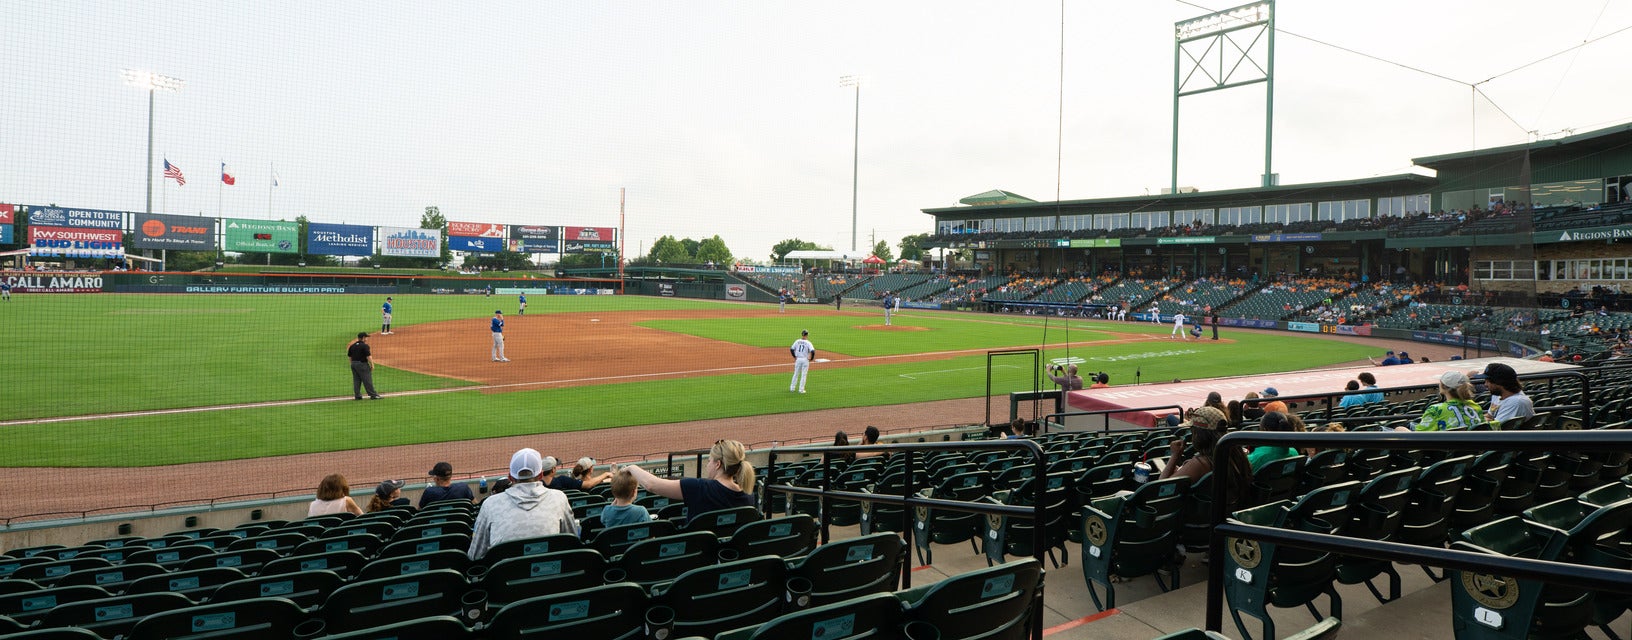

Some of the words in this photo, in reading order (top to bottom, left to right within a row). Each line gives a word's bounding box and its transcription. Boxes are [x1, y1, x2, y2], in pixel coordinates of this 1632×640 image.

[69, 210, 91, 218] OPEN
[93, 211, 103, 219] TO
[105, 212, 120, 220] THE
[69, 219, 120, 228] COMMUNITY
[171, 225, 208, 234] TRANE
[1573, 231, 1611, 240] REGIONS
[1613, 229, 1632, 238] BAN
[57, 231, 117, 241] SOUTHWEST
[313, 233, 368, 244] Methodist
[36, 238, 72, 249] BUD
[74, 240, 122, 250] LIGHT
[387, 238, 437, 250] HOUSTON
[7, 276, 45, 288] CALL
[49, 276, 103, 288] AMARO
[798, 344, 805, 352] 17
[1447, 405, 1482, 427] 19
[1240, 570, 1247, 580] K
[1483, 611, 1493, 623] L
